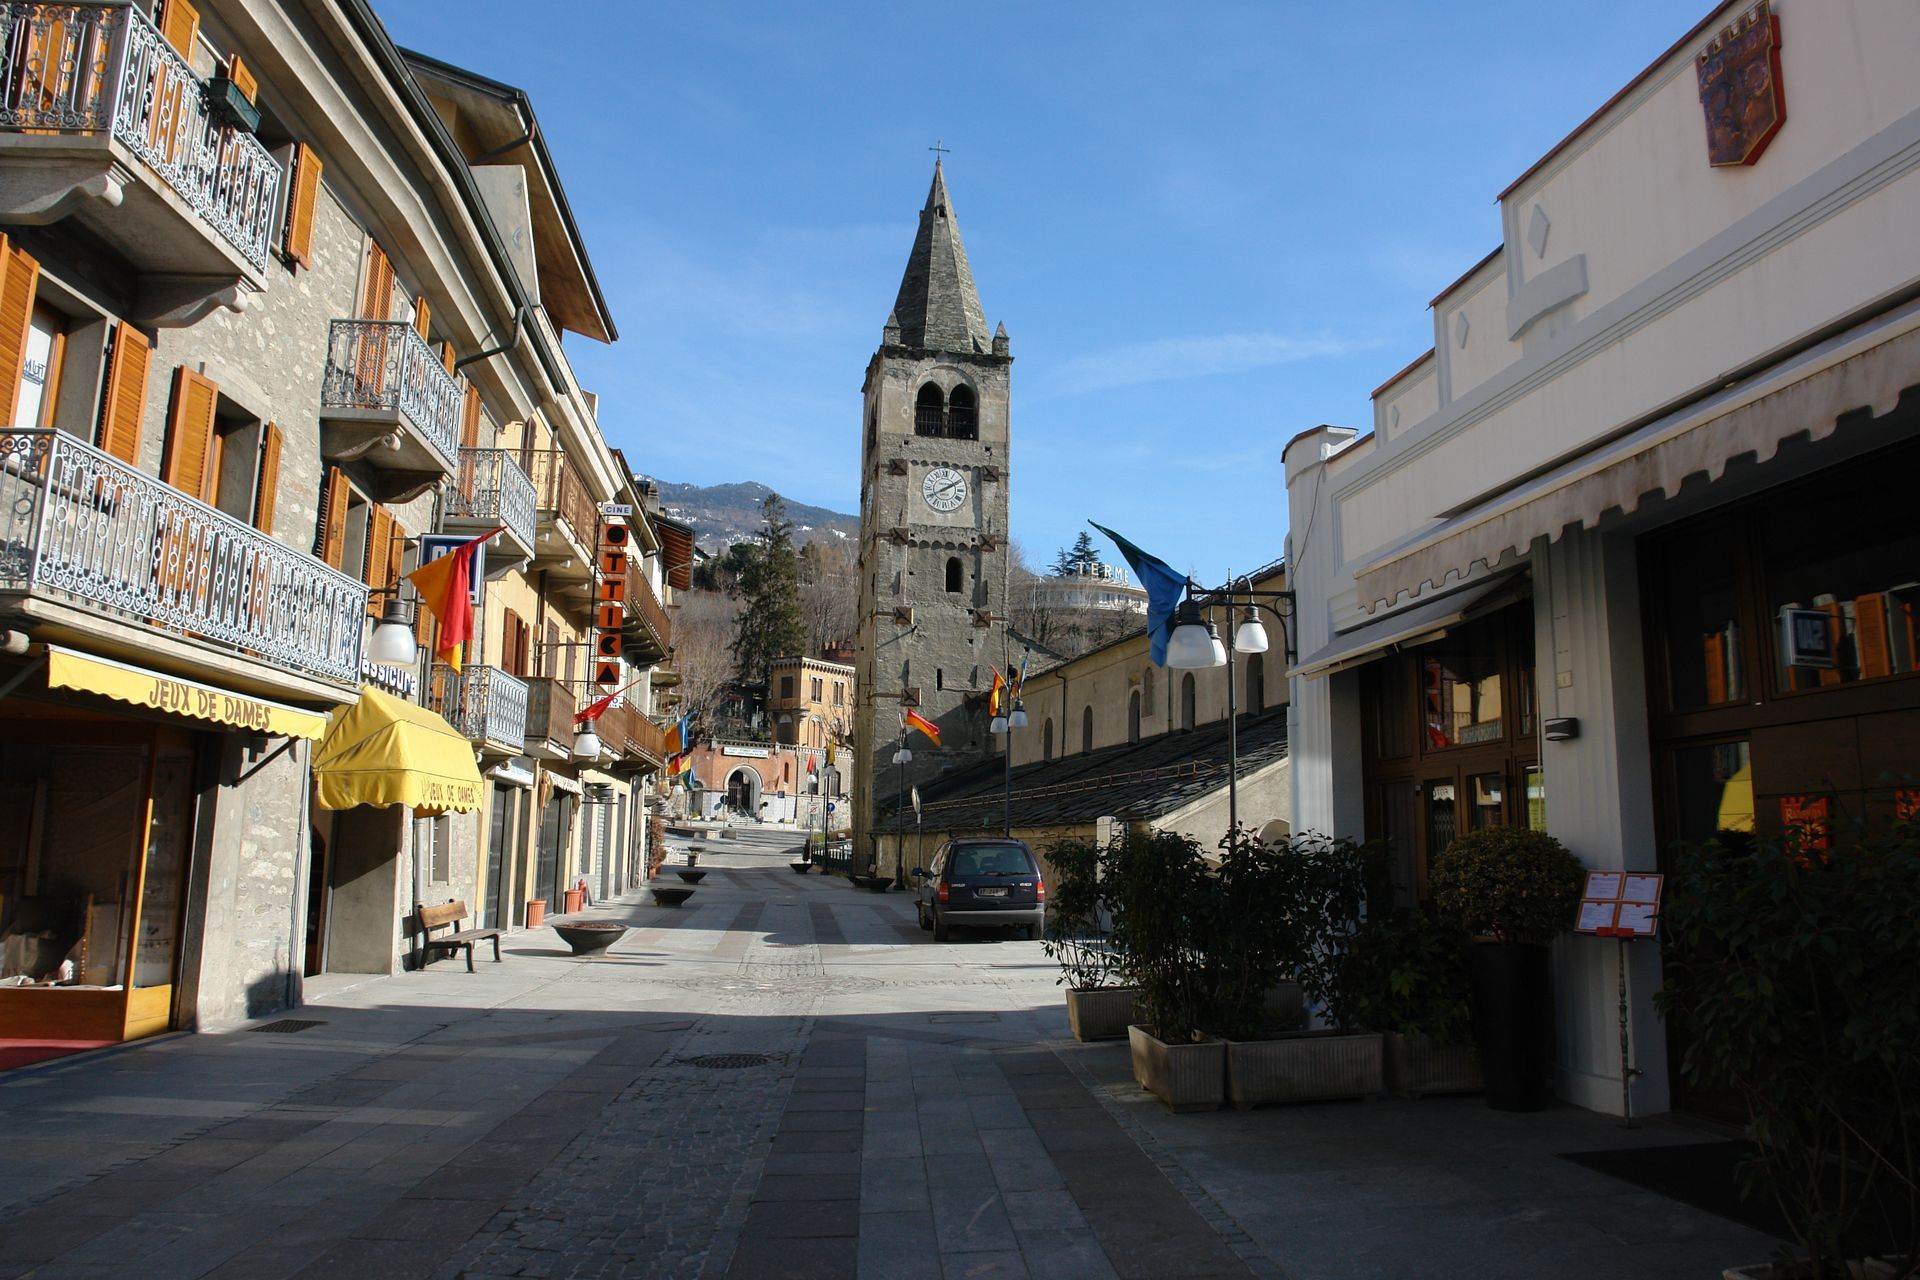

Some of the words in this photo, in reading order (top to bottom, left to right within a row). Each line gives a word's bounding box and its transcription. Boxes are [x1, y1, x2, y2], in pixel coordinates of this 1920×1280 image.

[606, 506, 630, 514] CINE
[1075, 561, 1129, 583] TERME
[597, 526, 625, 682] OTTICA
[150, 680, 189, 711] JEUX
[198, 689, 216, 719] DE
[225, 697, 271, 730] DAMES
[595, 696, 618, 704] FO
[430, 782, 443, 801] JEUX
[447, 784, 454, 802] DE
[458, 785, 474, 803] DAMES
